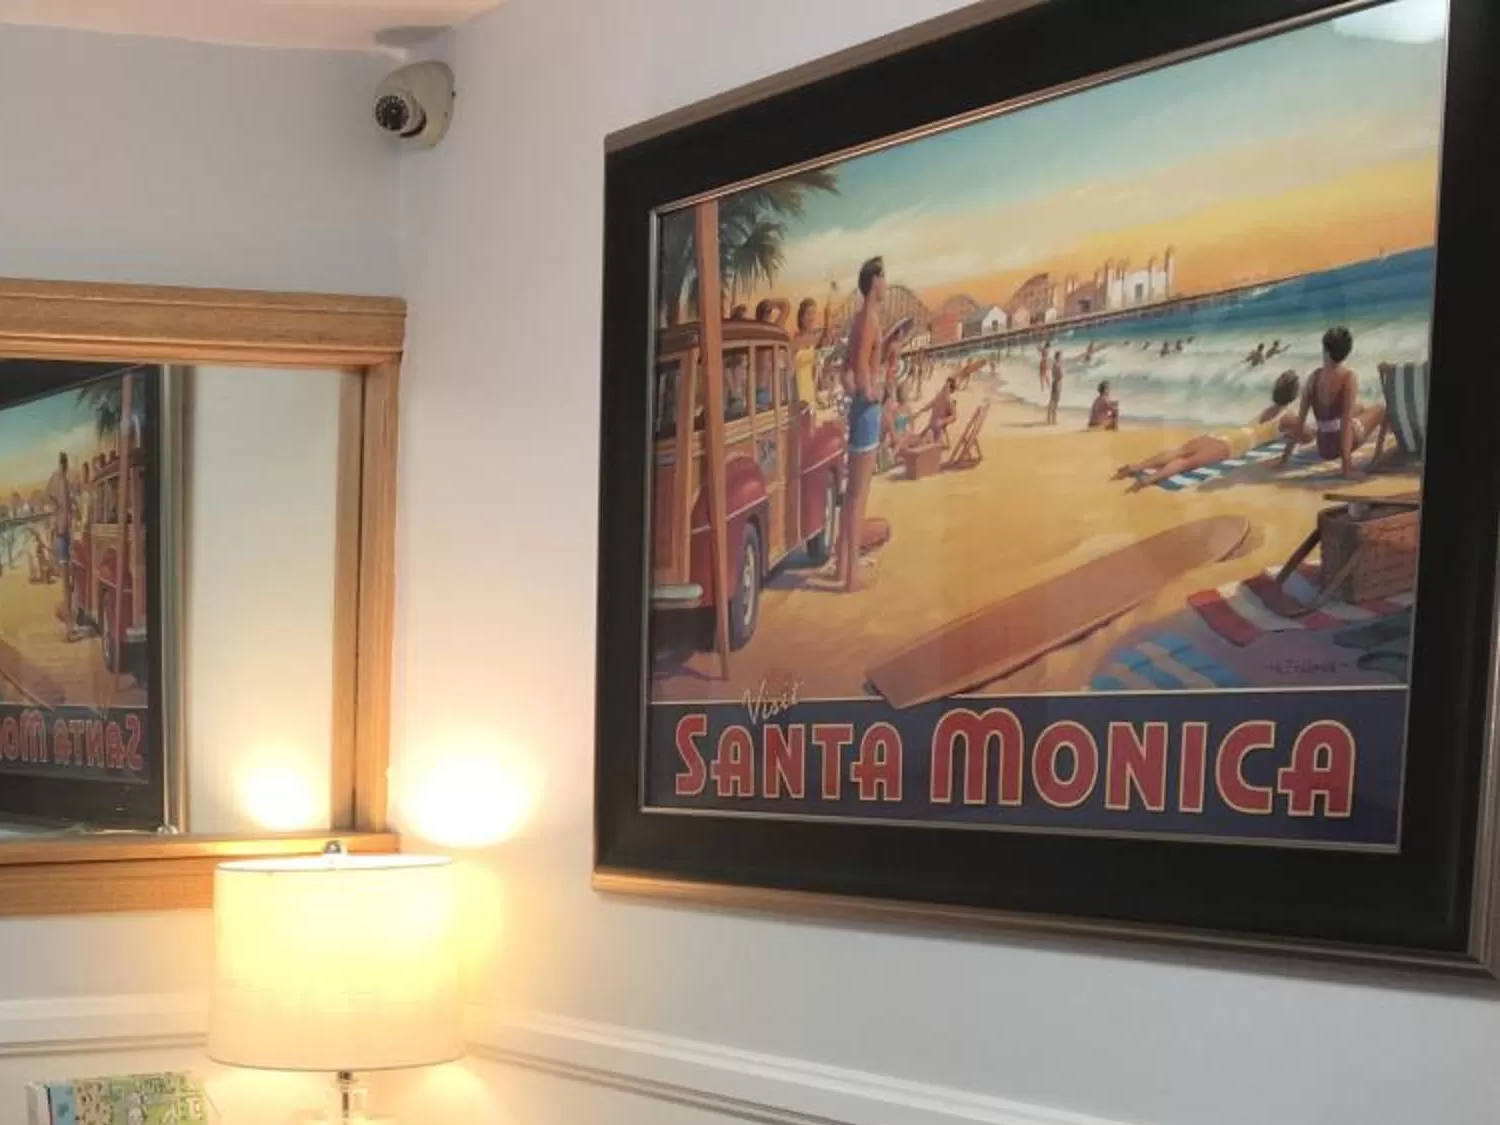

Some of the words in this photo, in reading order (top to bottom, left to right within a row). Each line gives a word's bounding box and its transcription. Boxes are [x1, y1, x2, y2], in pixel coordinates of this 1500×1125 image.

[741, 677, 804, 724] Visit
[674, 711, 903, 802] SANTA
[930, 707, 1357, 818] MONICA
